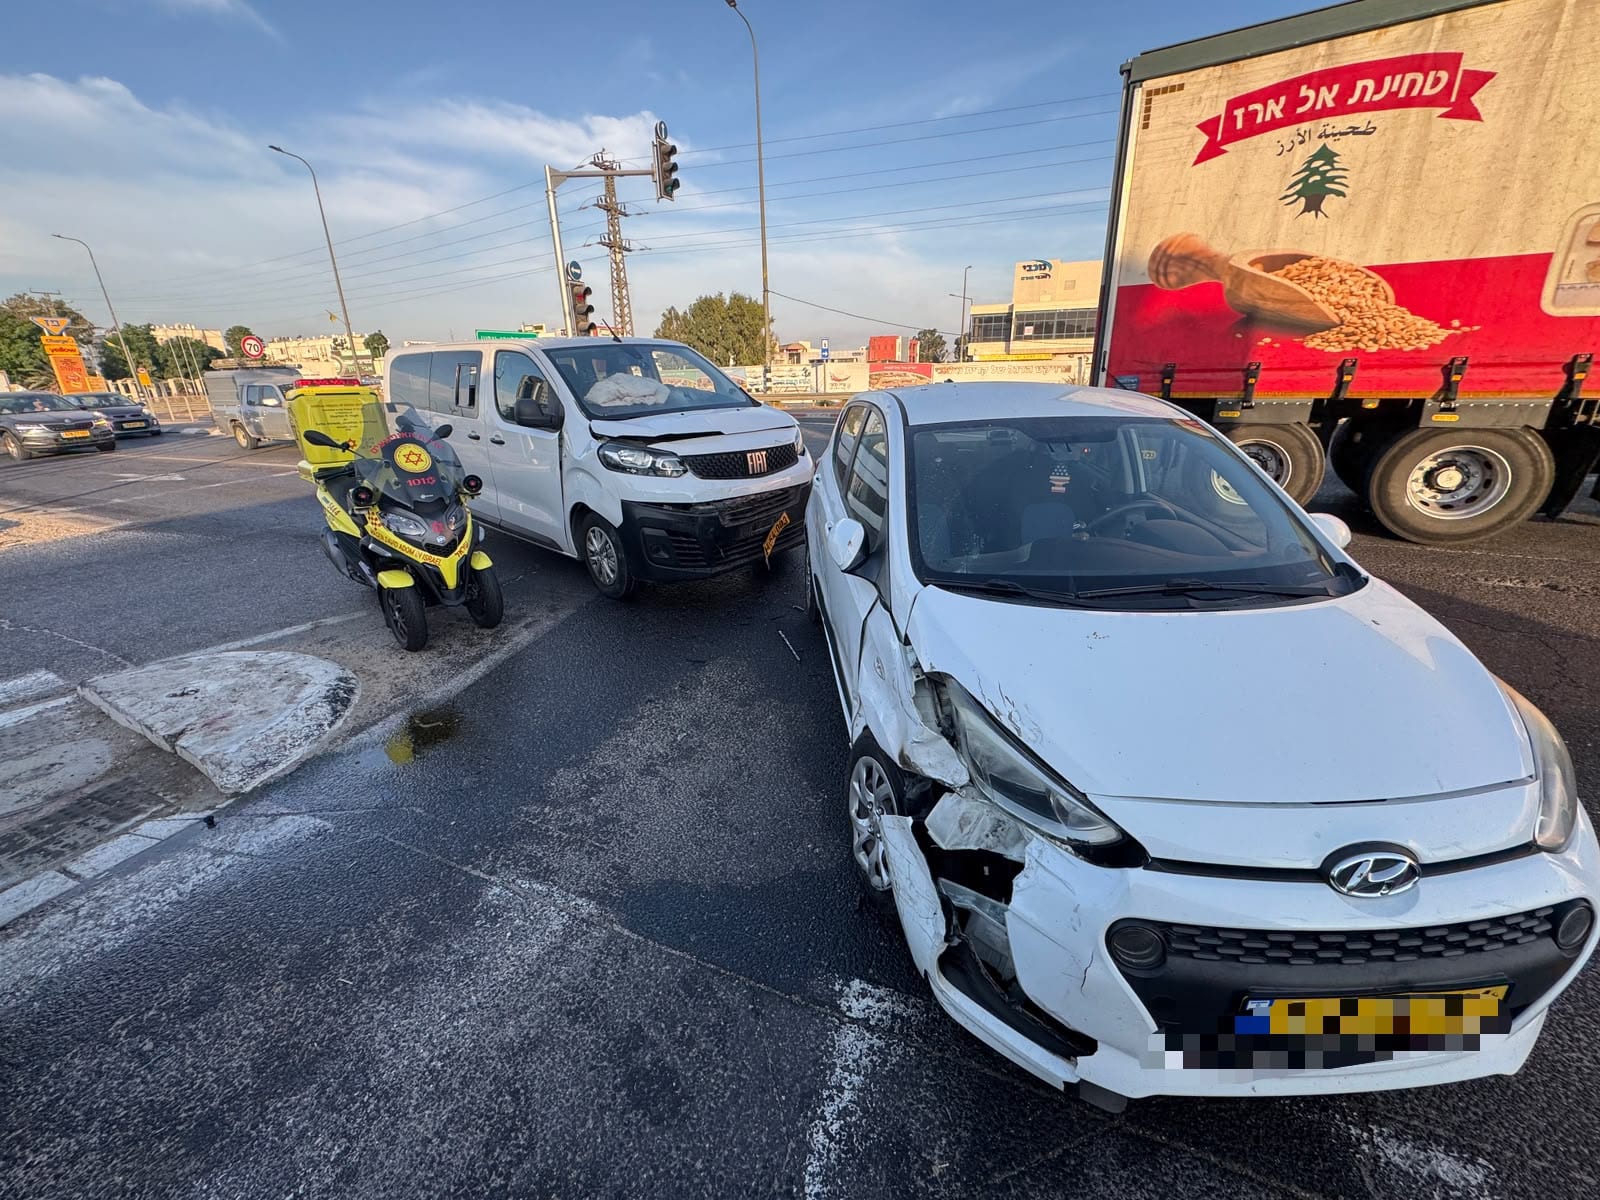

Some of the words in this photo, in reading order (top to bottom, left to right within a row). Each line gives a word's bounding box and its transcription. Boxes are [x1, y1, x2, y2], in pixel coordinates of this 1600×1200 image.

[1296, 83, 1339, 115] אל
[1347, 69, 1450, 106] טחינת
[1233, 96, 1287, 131] ארז
[1275, 128, 1312, 157] الأرز
[1317, 119, 1378, 142] طحينة
[1022, 263, 1047, 272] מכבי
[246, 342, 260, 353] 70
[746, 450, 768, 475] FIAT
[399, 543, 415, 555] ADOM
[422, 553, 442, 566] ISRAEL
